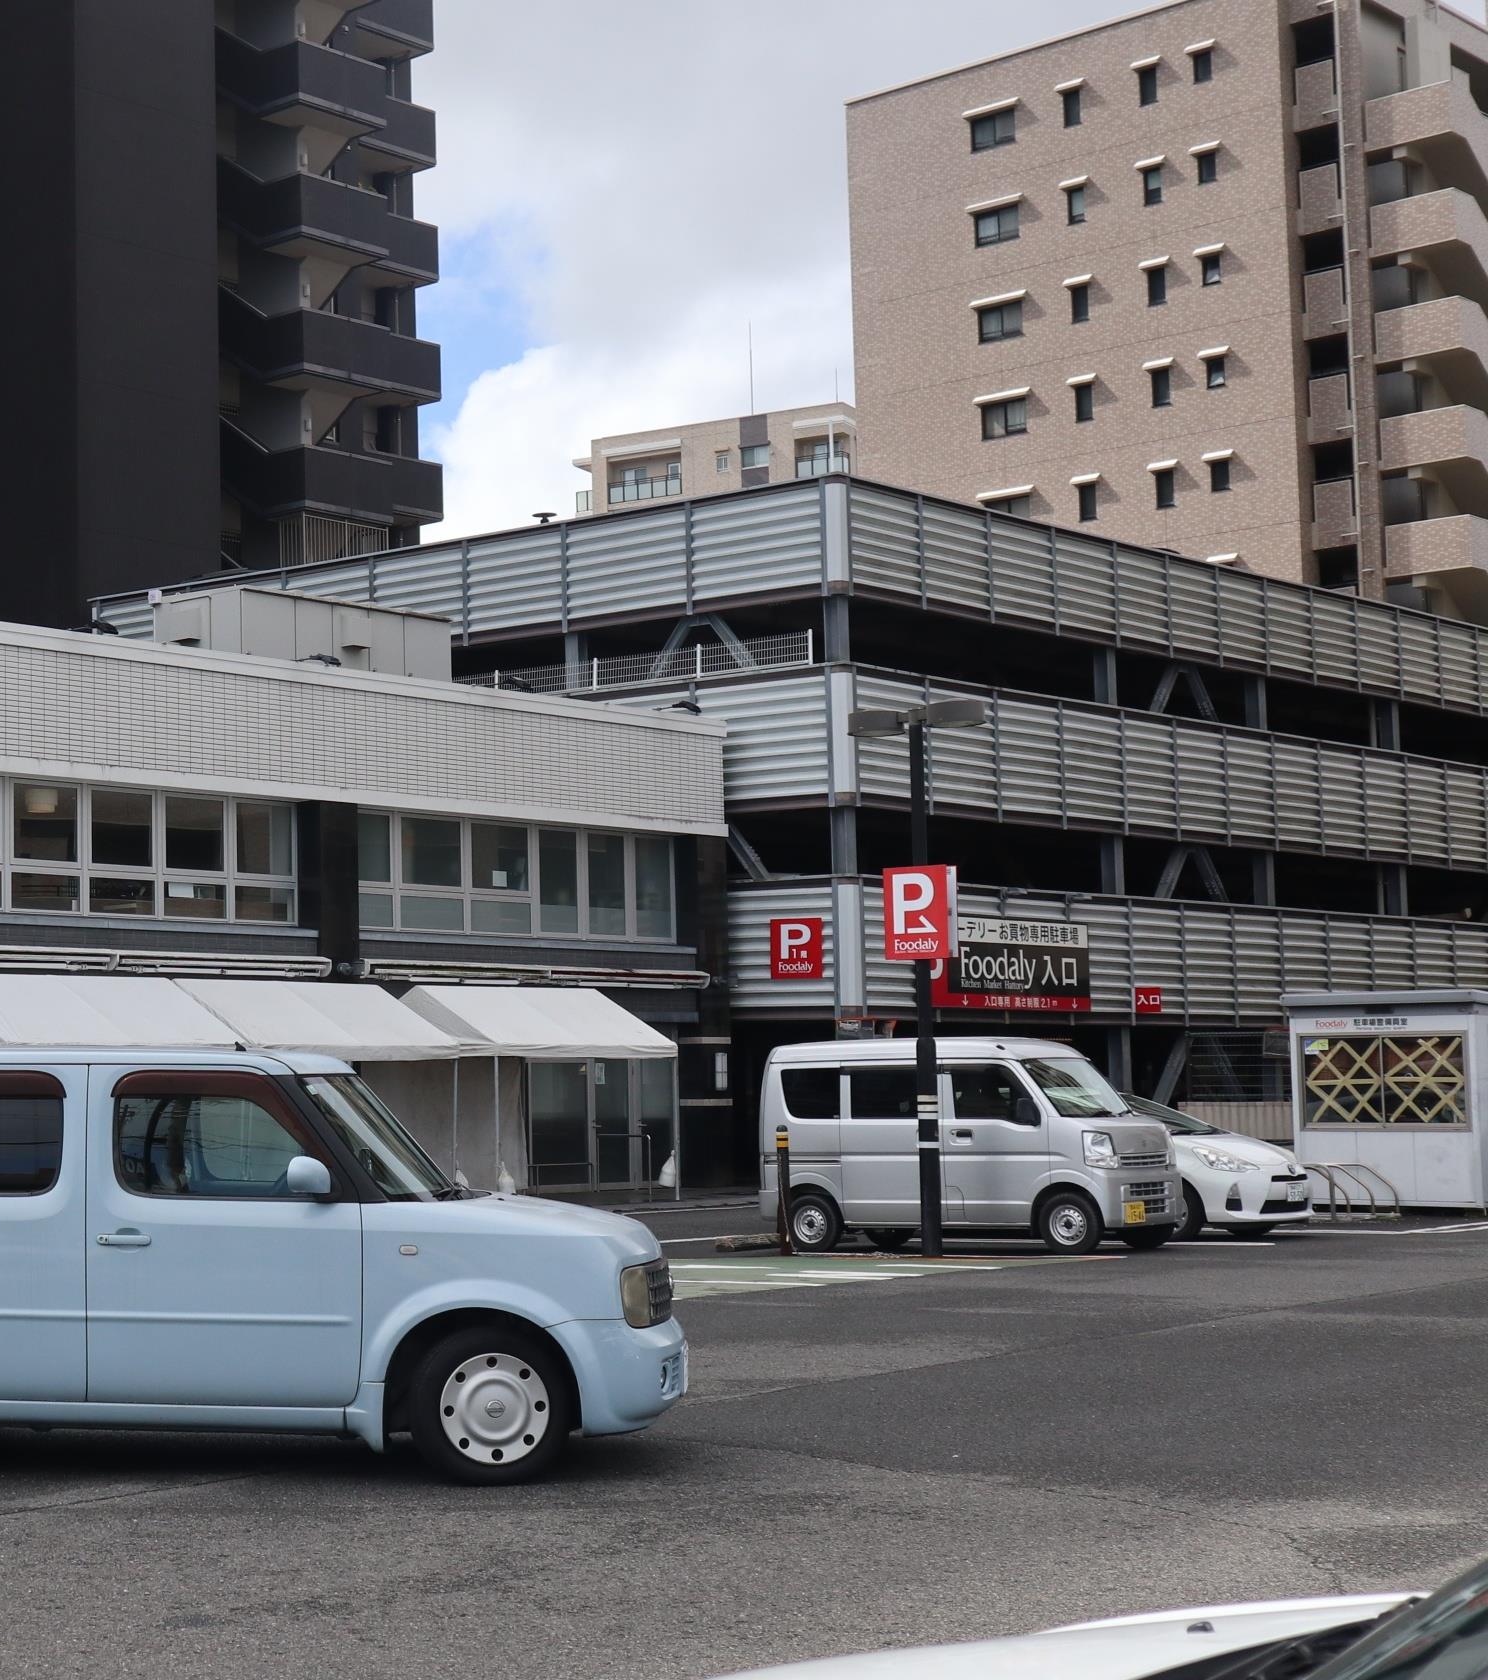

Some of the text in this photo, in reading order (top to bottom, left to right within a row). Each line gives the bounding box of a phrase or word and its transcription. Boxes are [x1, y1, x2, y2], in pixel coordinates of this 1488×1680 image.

[892, 872, 934, 934] P
[780, 923, 811, 959] P
[958, 921, 1080, 945] ーデリーお買物専用駐車場
[894, 937, 939, 953] Foodaly
[778, 961, 813, 974] Foodaly
[960, 946, 1036, 989] Foodaly
[1041, 955, 1078, 986] 入口
[1137, 994, 1160, 1006] 入口
[1315, 1019, 1347, 1029] Foodaly
